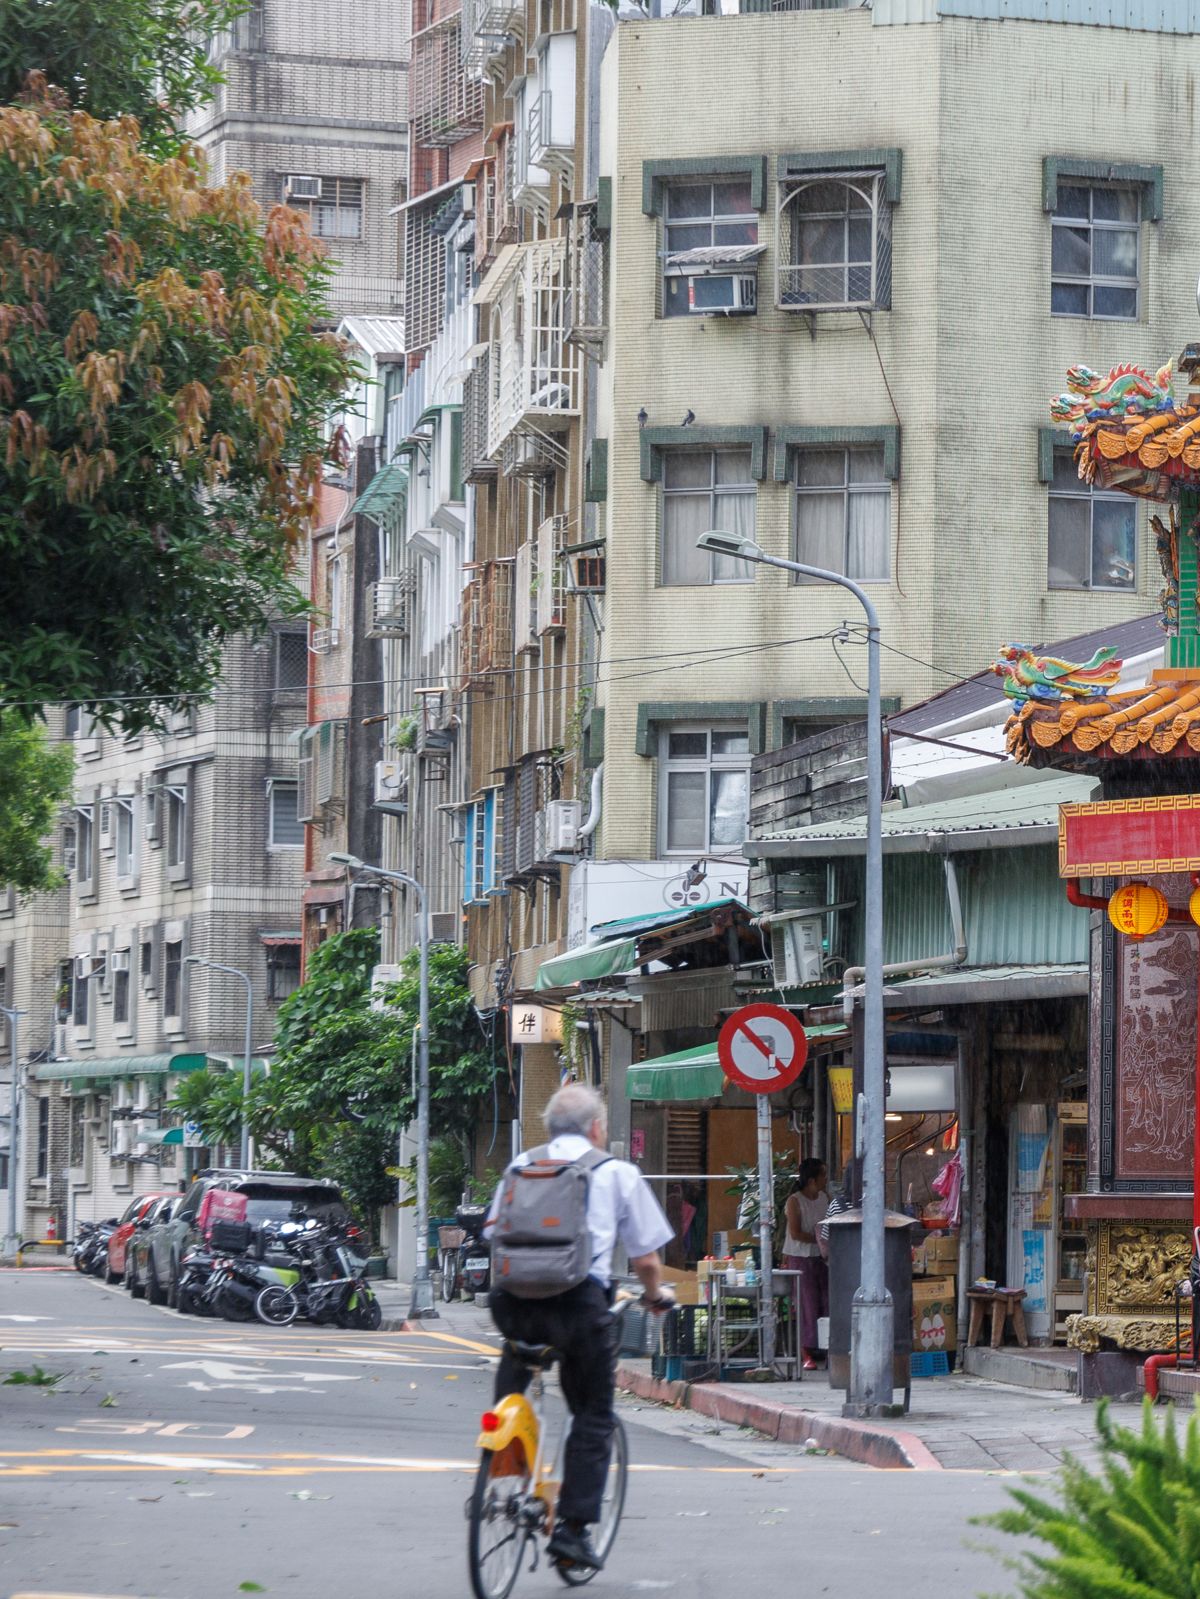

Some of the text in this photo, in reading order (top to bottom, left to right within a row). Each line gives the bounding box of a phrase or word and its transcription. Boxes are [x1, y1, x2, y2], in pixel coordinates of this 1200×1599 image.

[1121, 888, 1135, 928] 風調雨順
[518, 1013, 536, 1032] 伴
